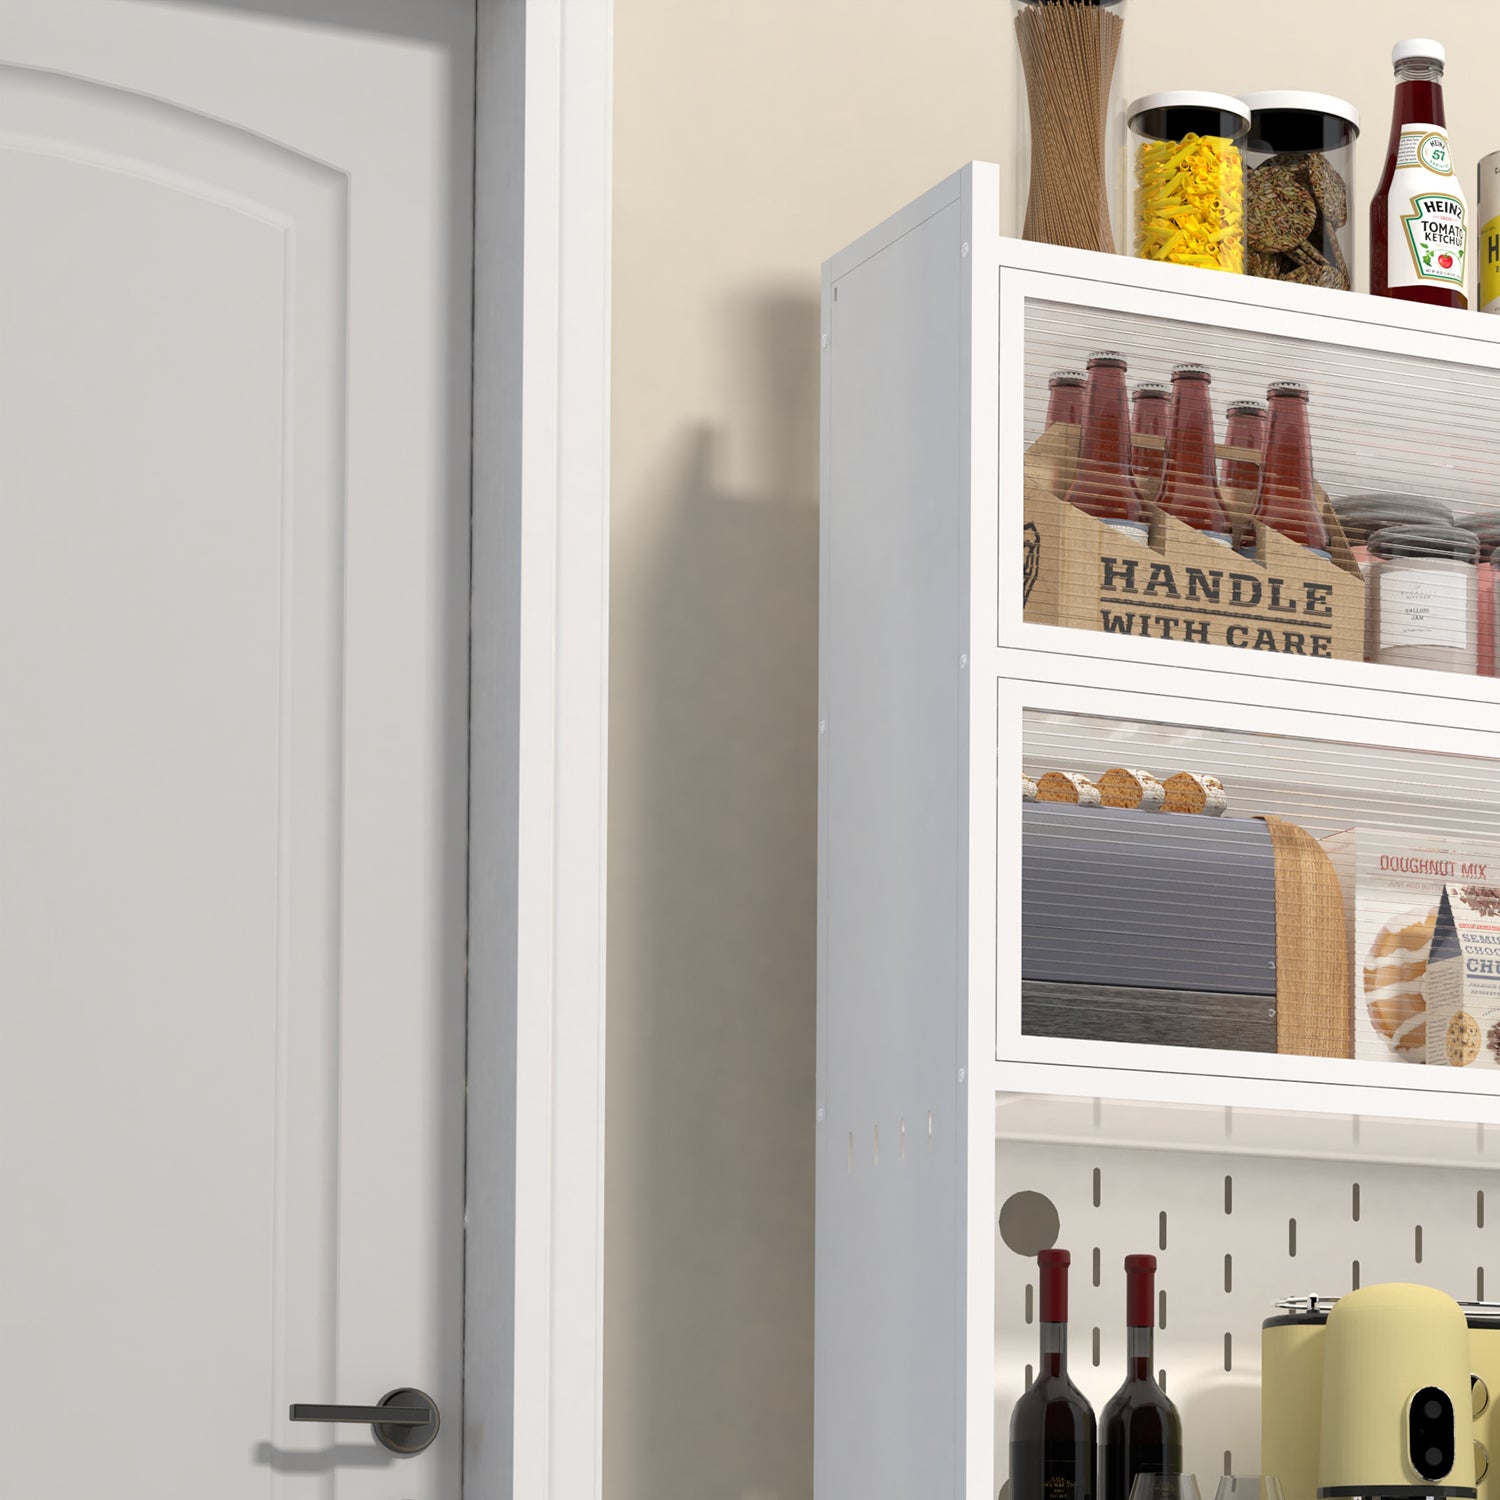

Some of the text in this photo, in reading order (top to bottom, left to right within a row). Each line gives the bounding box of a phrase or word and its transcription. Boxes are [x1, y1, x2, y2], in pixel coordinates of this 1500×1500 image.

[1432, 150, 1445, 161] 57
[1424, 201, 1462, 219] HEINZ
[1421, 221, 1462, 240] TOMATO
[1100, 556, 1333, 617] HANDLE
[1100, 609, 1332, 658] WITH CARE
[1380, 855, 1487, 880] DOUGHNUT MIX
